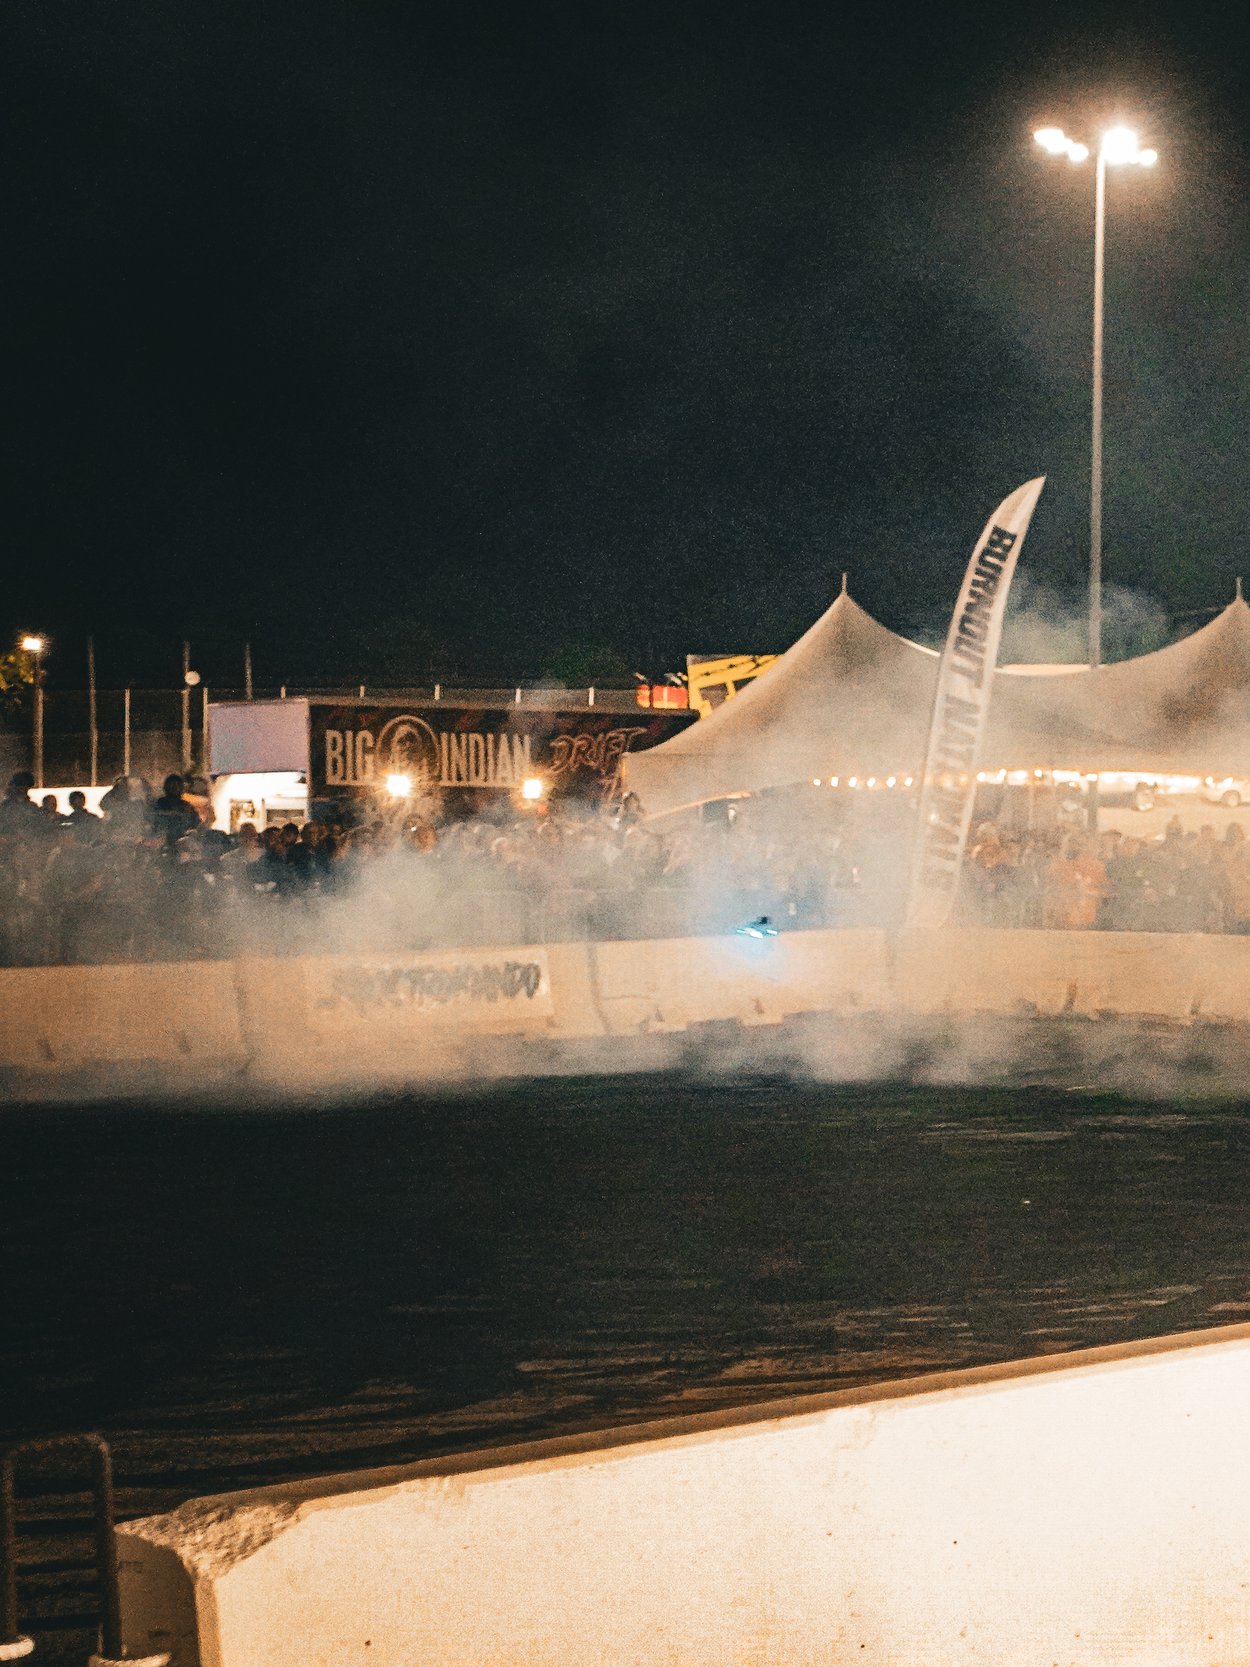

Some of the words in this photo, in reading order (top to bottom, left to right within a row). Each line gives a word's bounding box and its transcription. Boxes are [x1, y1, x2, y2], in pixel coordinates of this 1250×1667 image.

[950, 525, 1017, 688] BURNOUT
[325, 729, 375, 786] BIG
[440, 731, 531, 787] INDIAN
